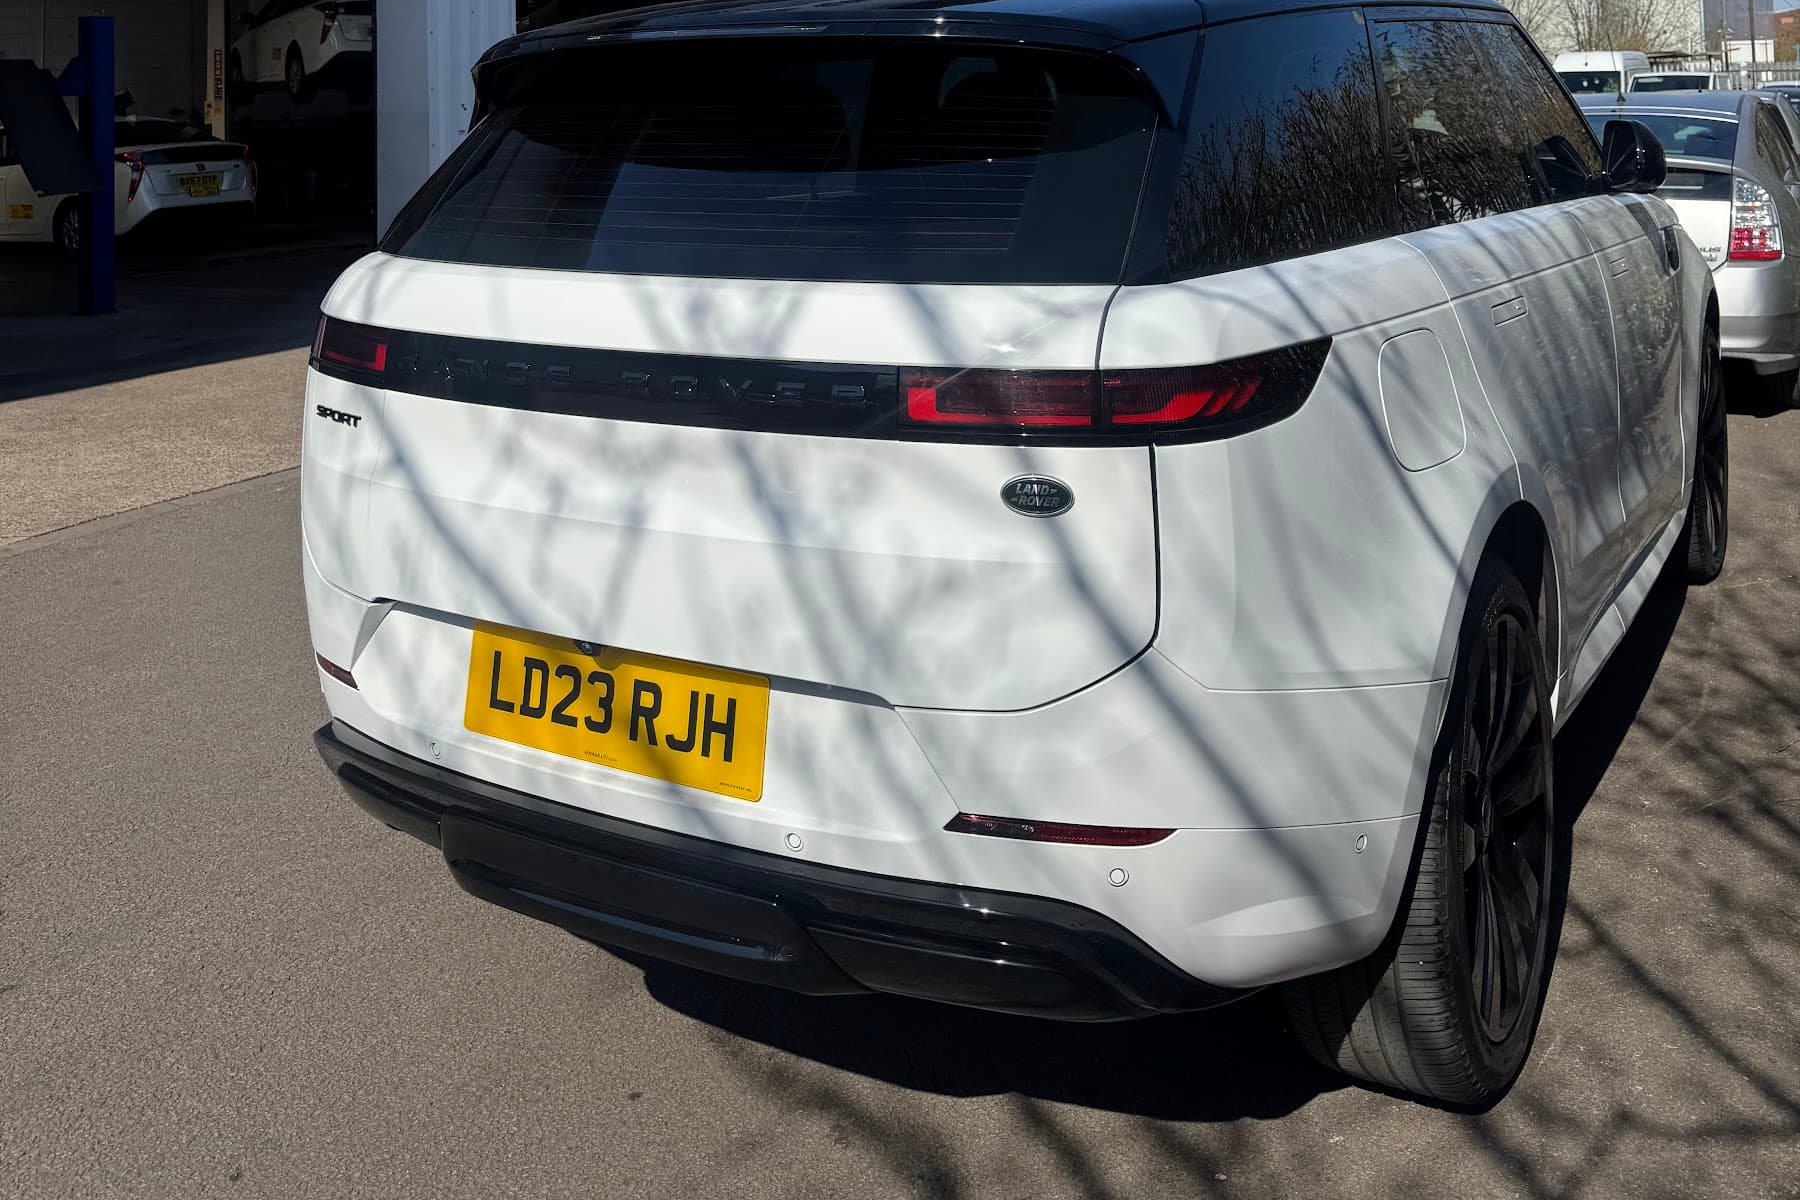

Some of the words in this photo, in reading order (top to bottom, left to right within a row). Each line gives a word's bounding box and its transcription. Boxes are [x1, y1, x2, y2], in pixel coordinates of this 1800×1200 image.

[316, 404, 362, 428] SPORT
[1016, 483, 1049, 495] LAND
[1018, 496, 1060, 507] ROVER
[489, 650, 616, 734] LD23
[629, 678, 737, 763] RJH
